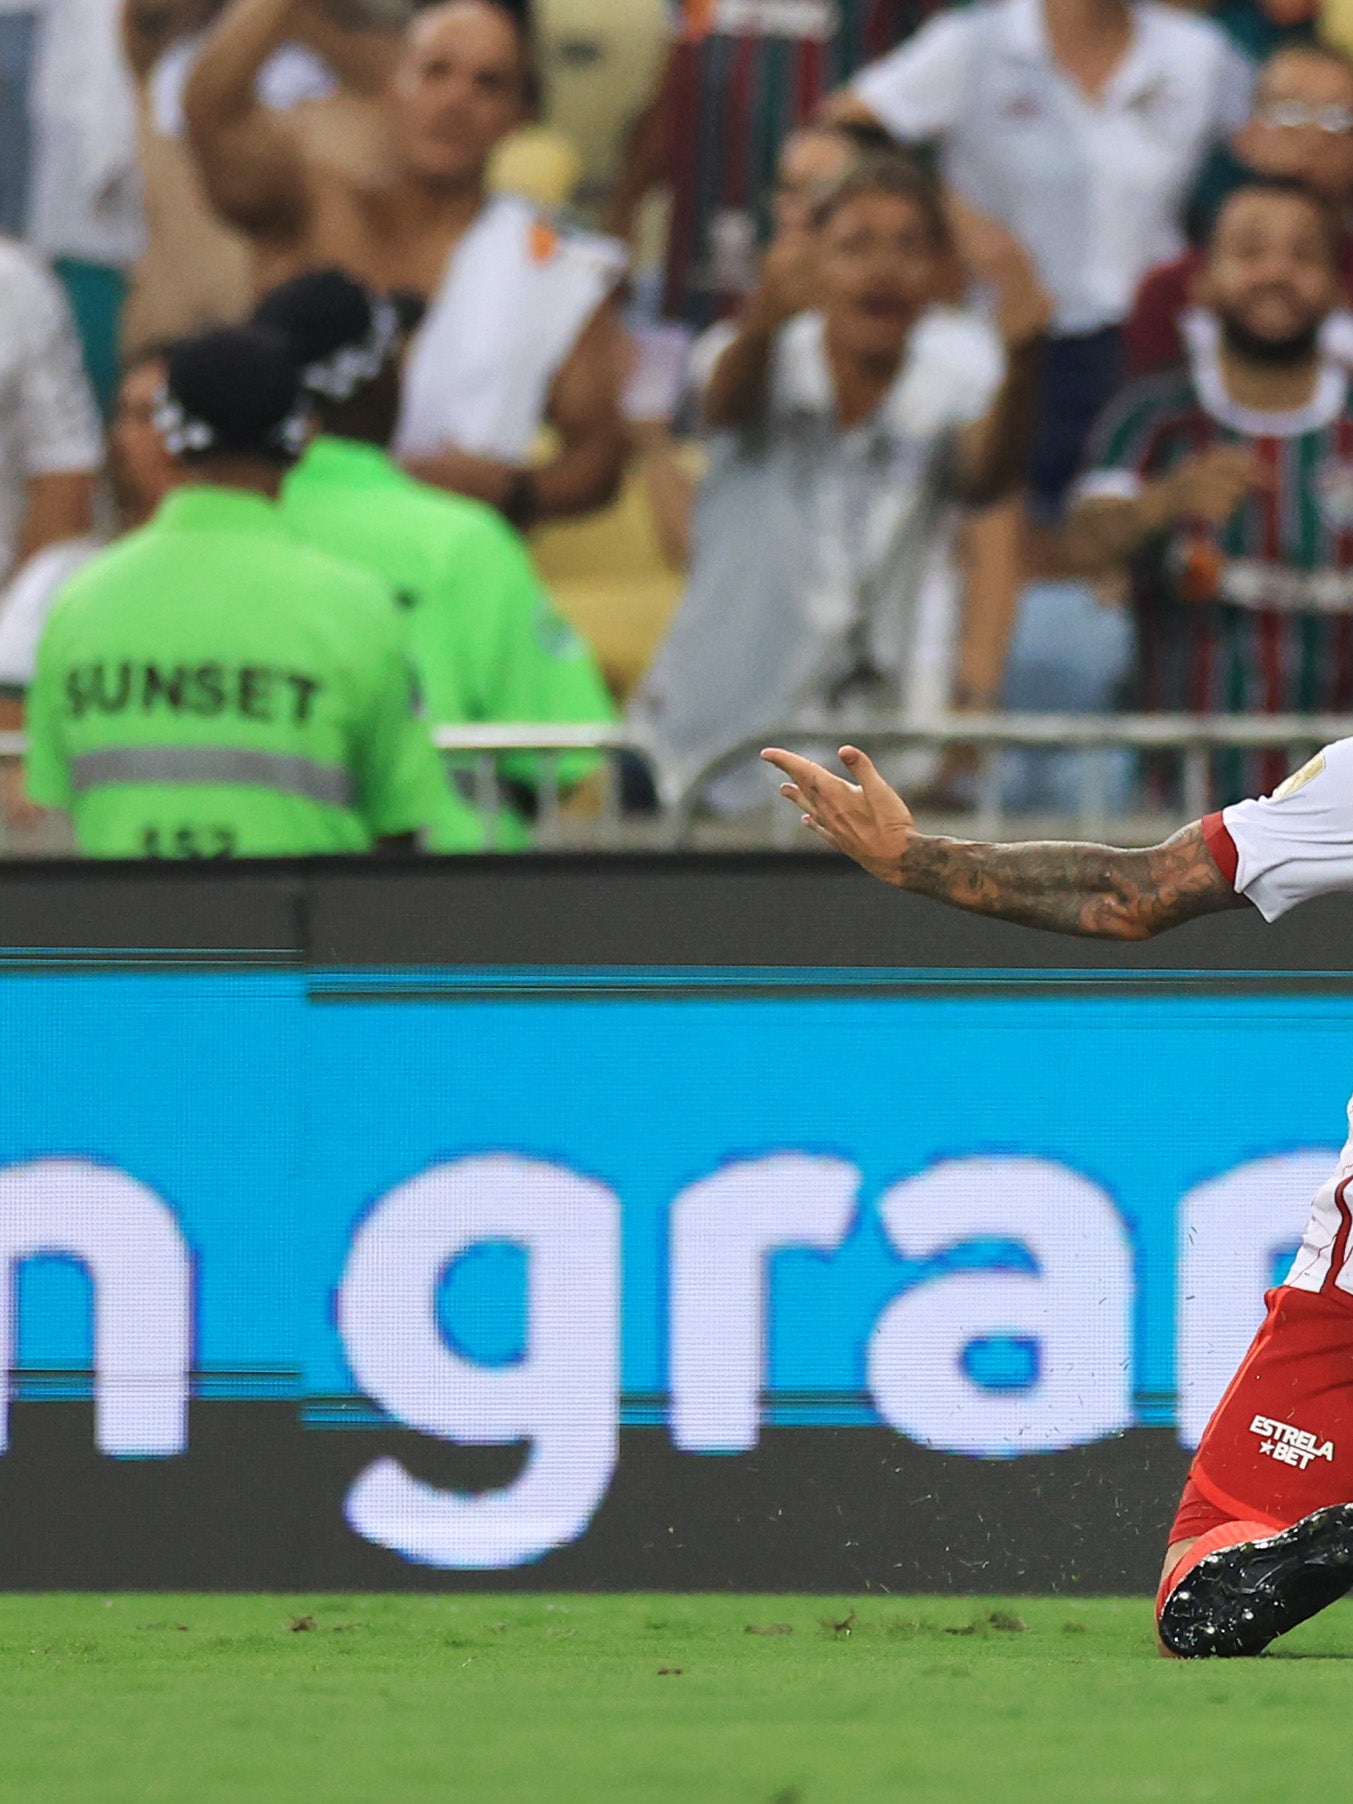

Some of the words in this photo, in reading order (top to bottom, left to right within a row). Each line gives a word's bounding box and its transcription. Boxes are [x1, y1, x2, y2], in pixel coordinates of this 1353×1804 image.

[66, 660, 318, 728] SUNSET
[1249, 1414, 1335, 1462] ESTRELA
[1272, 1441, 1315, 1470] BET
